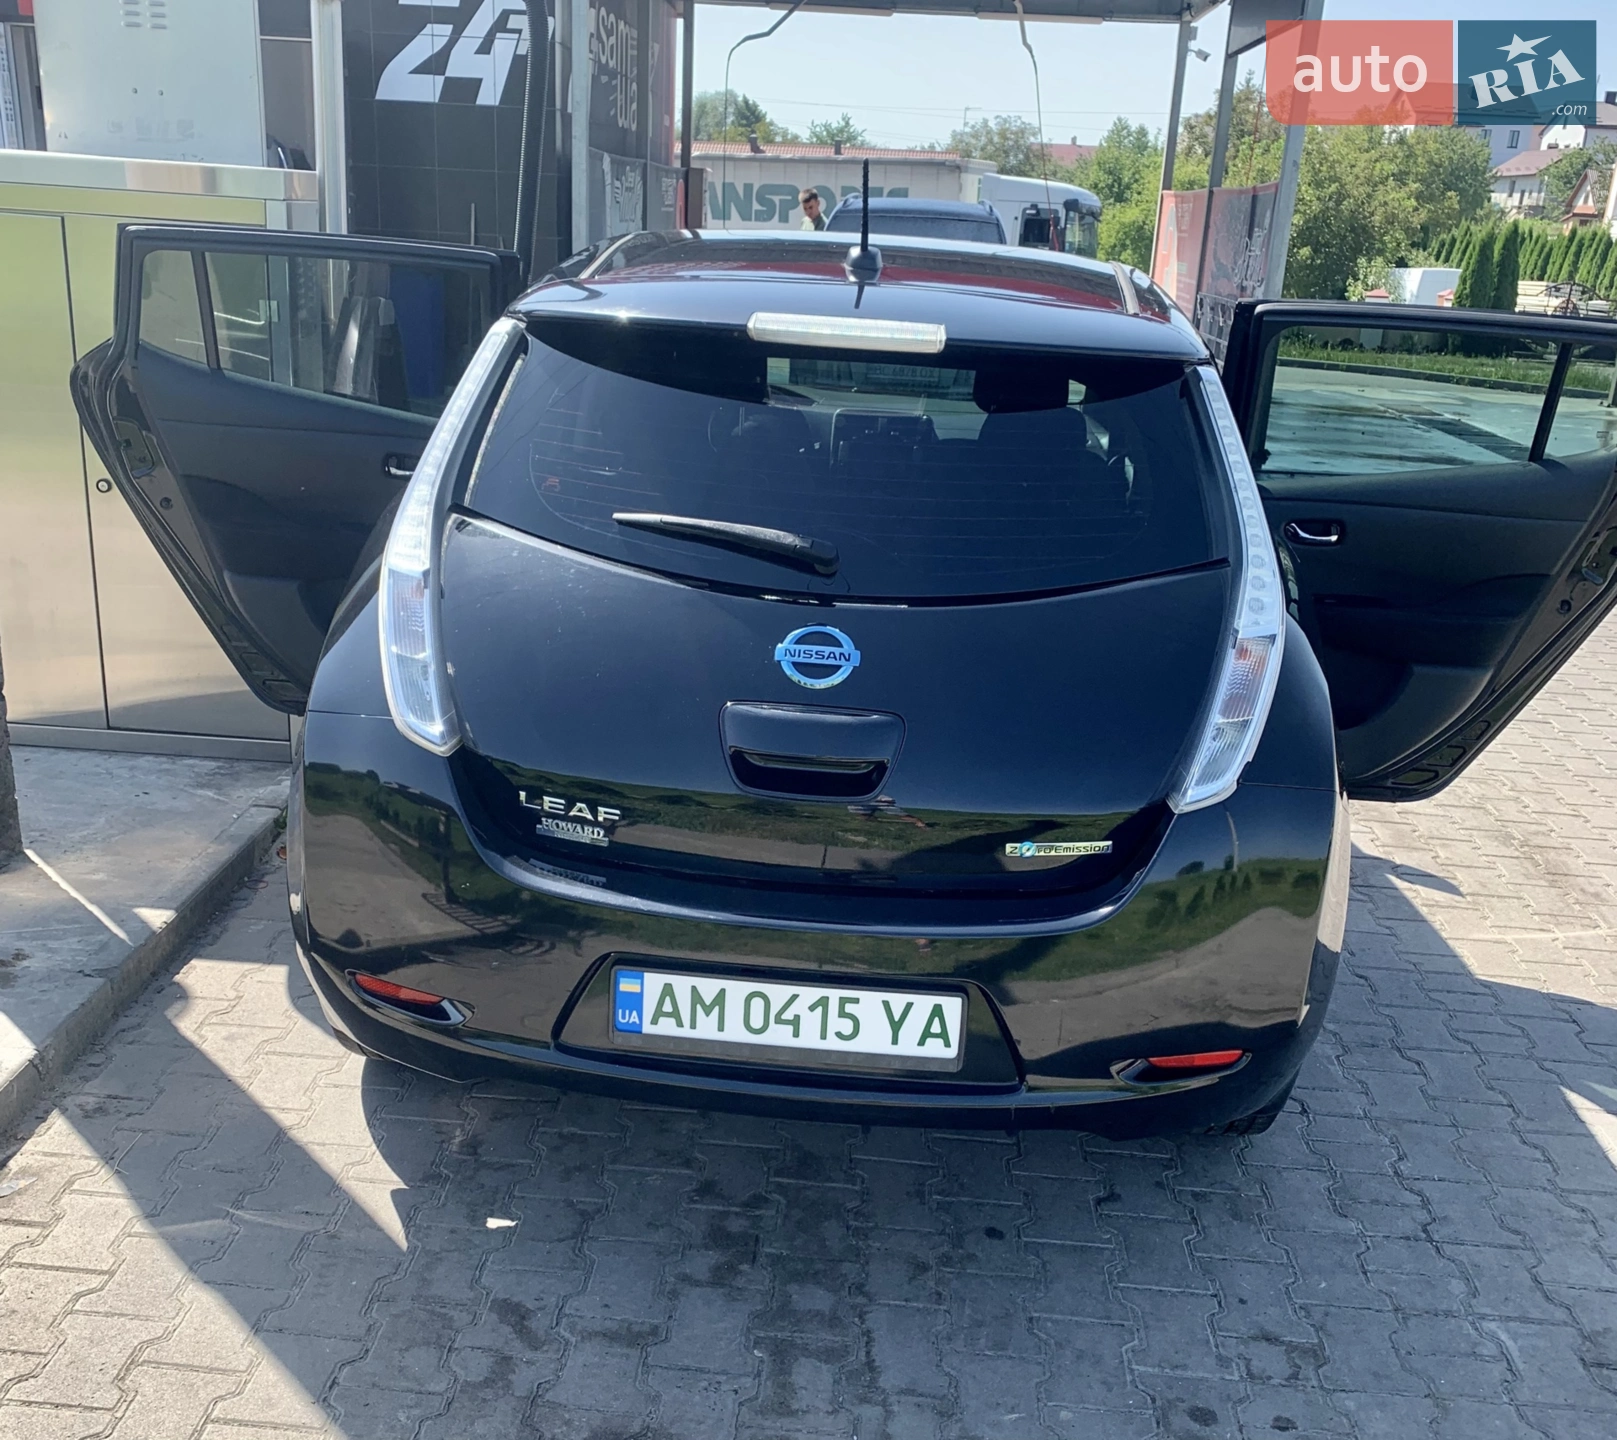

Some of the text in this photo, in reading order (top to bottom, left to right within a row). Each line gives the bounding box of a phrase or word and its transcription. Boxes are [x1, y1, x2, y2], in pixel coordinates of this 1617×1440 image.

[784, 648, 852, 663] NISSAN
[518, 790, 622, 823] LEAF
[540, 817, 606, 839] HOWARD
[617, 1009, 640, 1026] UA
[649, 982, 952, 1049] AM 0415 YA
